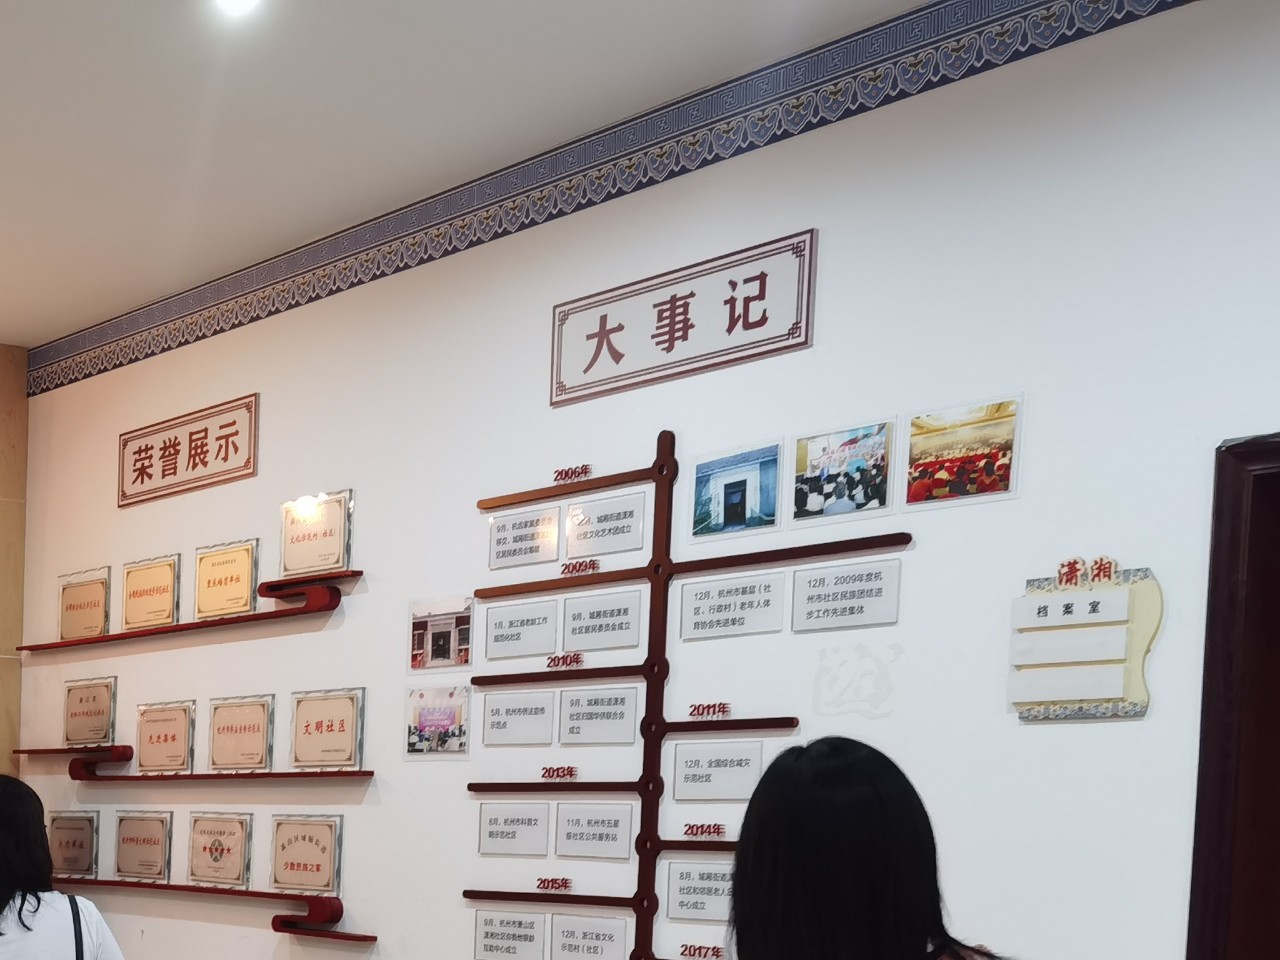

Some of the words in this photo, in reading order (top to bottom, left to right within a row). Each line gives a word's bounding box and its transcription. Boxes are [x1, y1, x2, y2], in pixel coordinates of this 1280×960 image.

[583, 271, 769, 375] 大事记
[132, 420, 240, 486] 荣誉展示
[553, 464, 591, 482] 2006年
[561, 559, 599, 576] 2009年
[1058, 558, 1112, 585] 潇湘
[807, 571, 883, 589] 12月，2009年度杭
[694, 583, 771, 601] 12月，杭州市基层（社
[806, 587, 883, 604] 州市社区民族团结进
[571, 607, 629, 621] 9月，城厢街道潇湘
[693, 599, 771, 616] 区、行政村）老年人体
[806, 604, 865, 620] 步工作先进集体
[1036, 601, 1101, 618] 档案室
[571, 621, 631, 635] 社区居民委员会成立
[693, 616, 746, 631] 育协会先进单位
[546, 653, 583, 669] 2010年
[570, 697, 626, 708] 9月，城厢街道潇湘
[689, 702, 730, 717] 2011年
[303, 719, 345, 735] 文明社区
[568, 726, 581, 735] 成立
[541, 766, 577, 780] 2013年
[683, 773, 712, 783] 示范社区
[567, 818, 620, 828] 11月，杭州市五星
[683, 823, 725, 837] 2014年
[283, 861, 322, 873] 少数民族之家
[679, 871, 733, 882] 8月，城厢街道
[537, 878, 572, 891] 2015年
[678, 899, 707, 911] 中心成立
[483, 918, 535, 930] 9月，杭州市萧山区
[561, 930, 615, 943] 12月，浙江省文化
[561, 942, 604, 955] 示范村（社区）
[680, 944, 724, 959] 2017年
